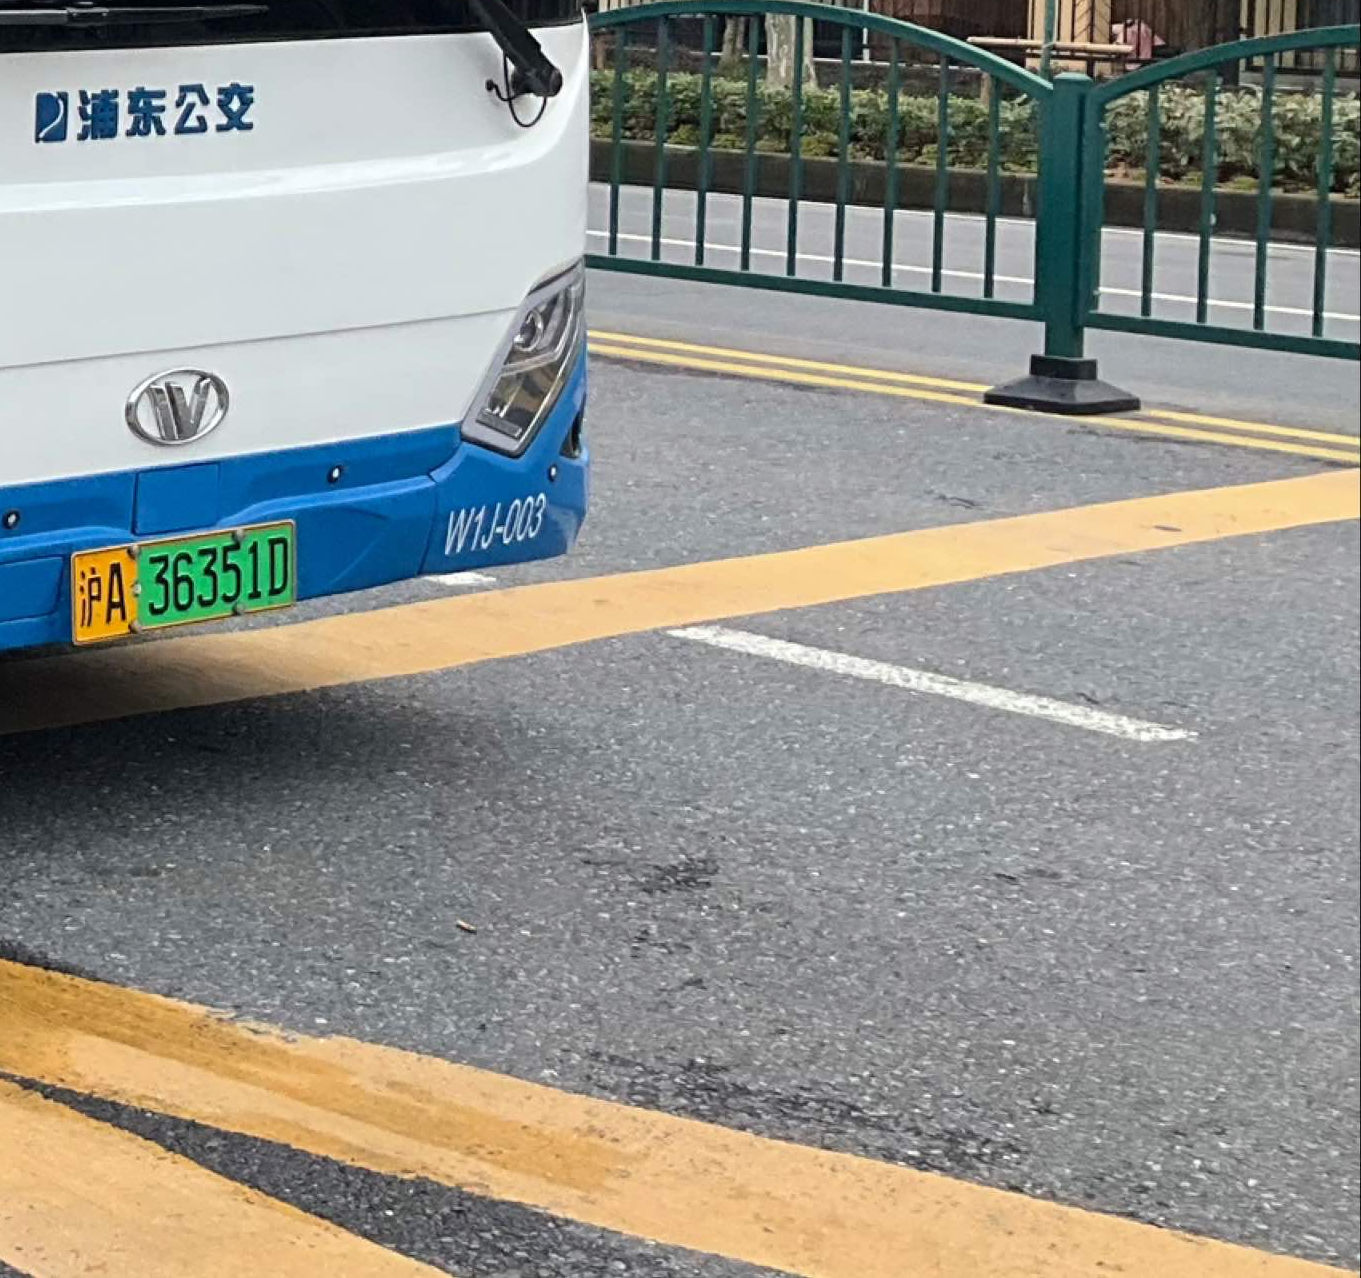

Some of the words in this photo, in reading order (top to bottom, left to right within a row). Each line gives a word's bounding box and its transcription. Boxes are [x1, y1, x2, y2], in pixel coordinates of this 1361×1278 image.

[77, 82, 254, 141] 浦东公交
[444, 492, 547, 555] W1J-003
[80, 562, 126, 627] 沪A
[149, 537, 289, 615] 36351D
